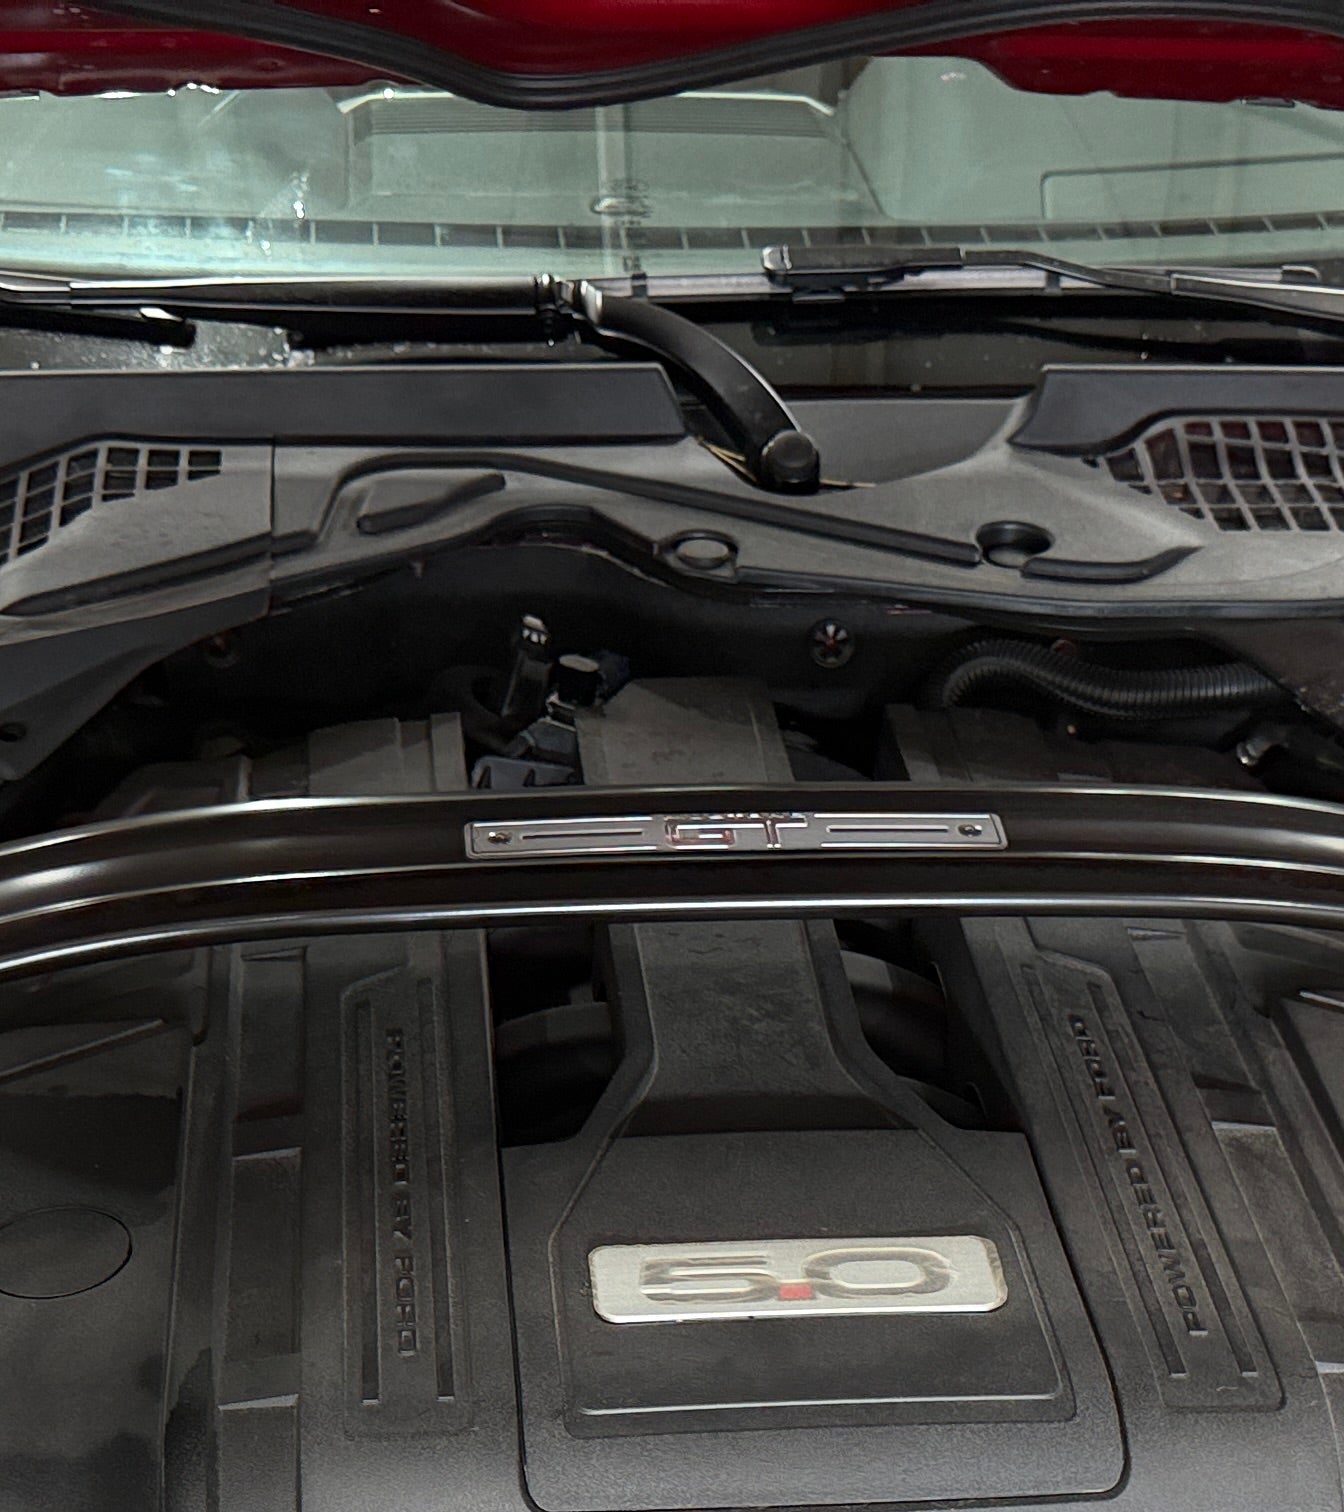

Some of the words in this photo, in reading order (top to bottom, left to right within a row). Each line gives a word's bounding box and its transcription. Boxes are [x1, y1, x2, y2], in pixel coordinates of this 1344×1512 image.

[664, 815, 808, 849] GT
[1068, 1013, 1116, 1100] FORD
[1102, 1106, 1136, 1154] BY
[639, 1246, 952, 1304] 5.0
[1127, 1161, 1208, 1336] POWERED
[394, 1256, 417, 1357] FORD
